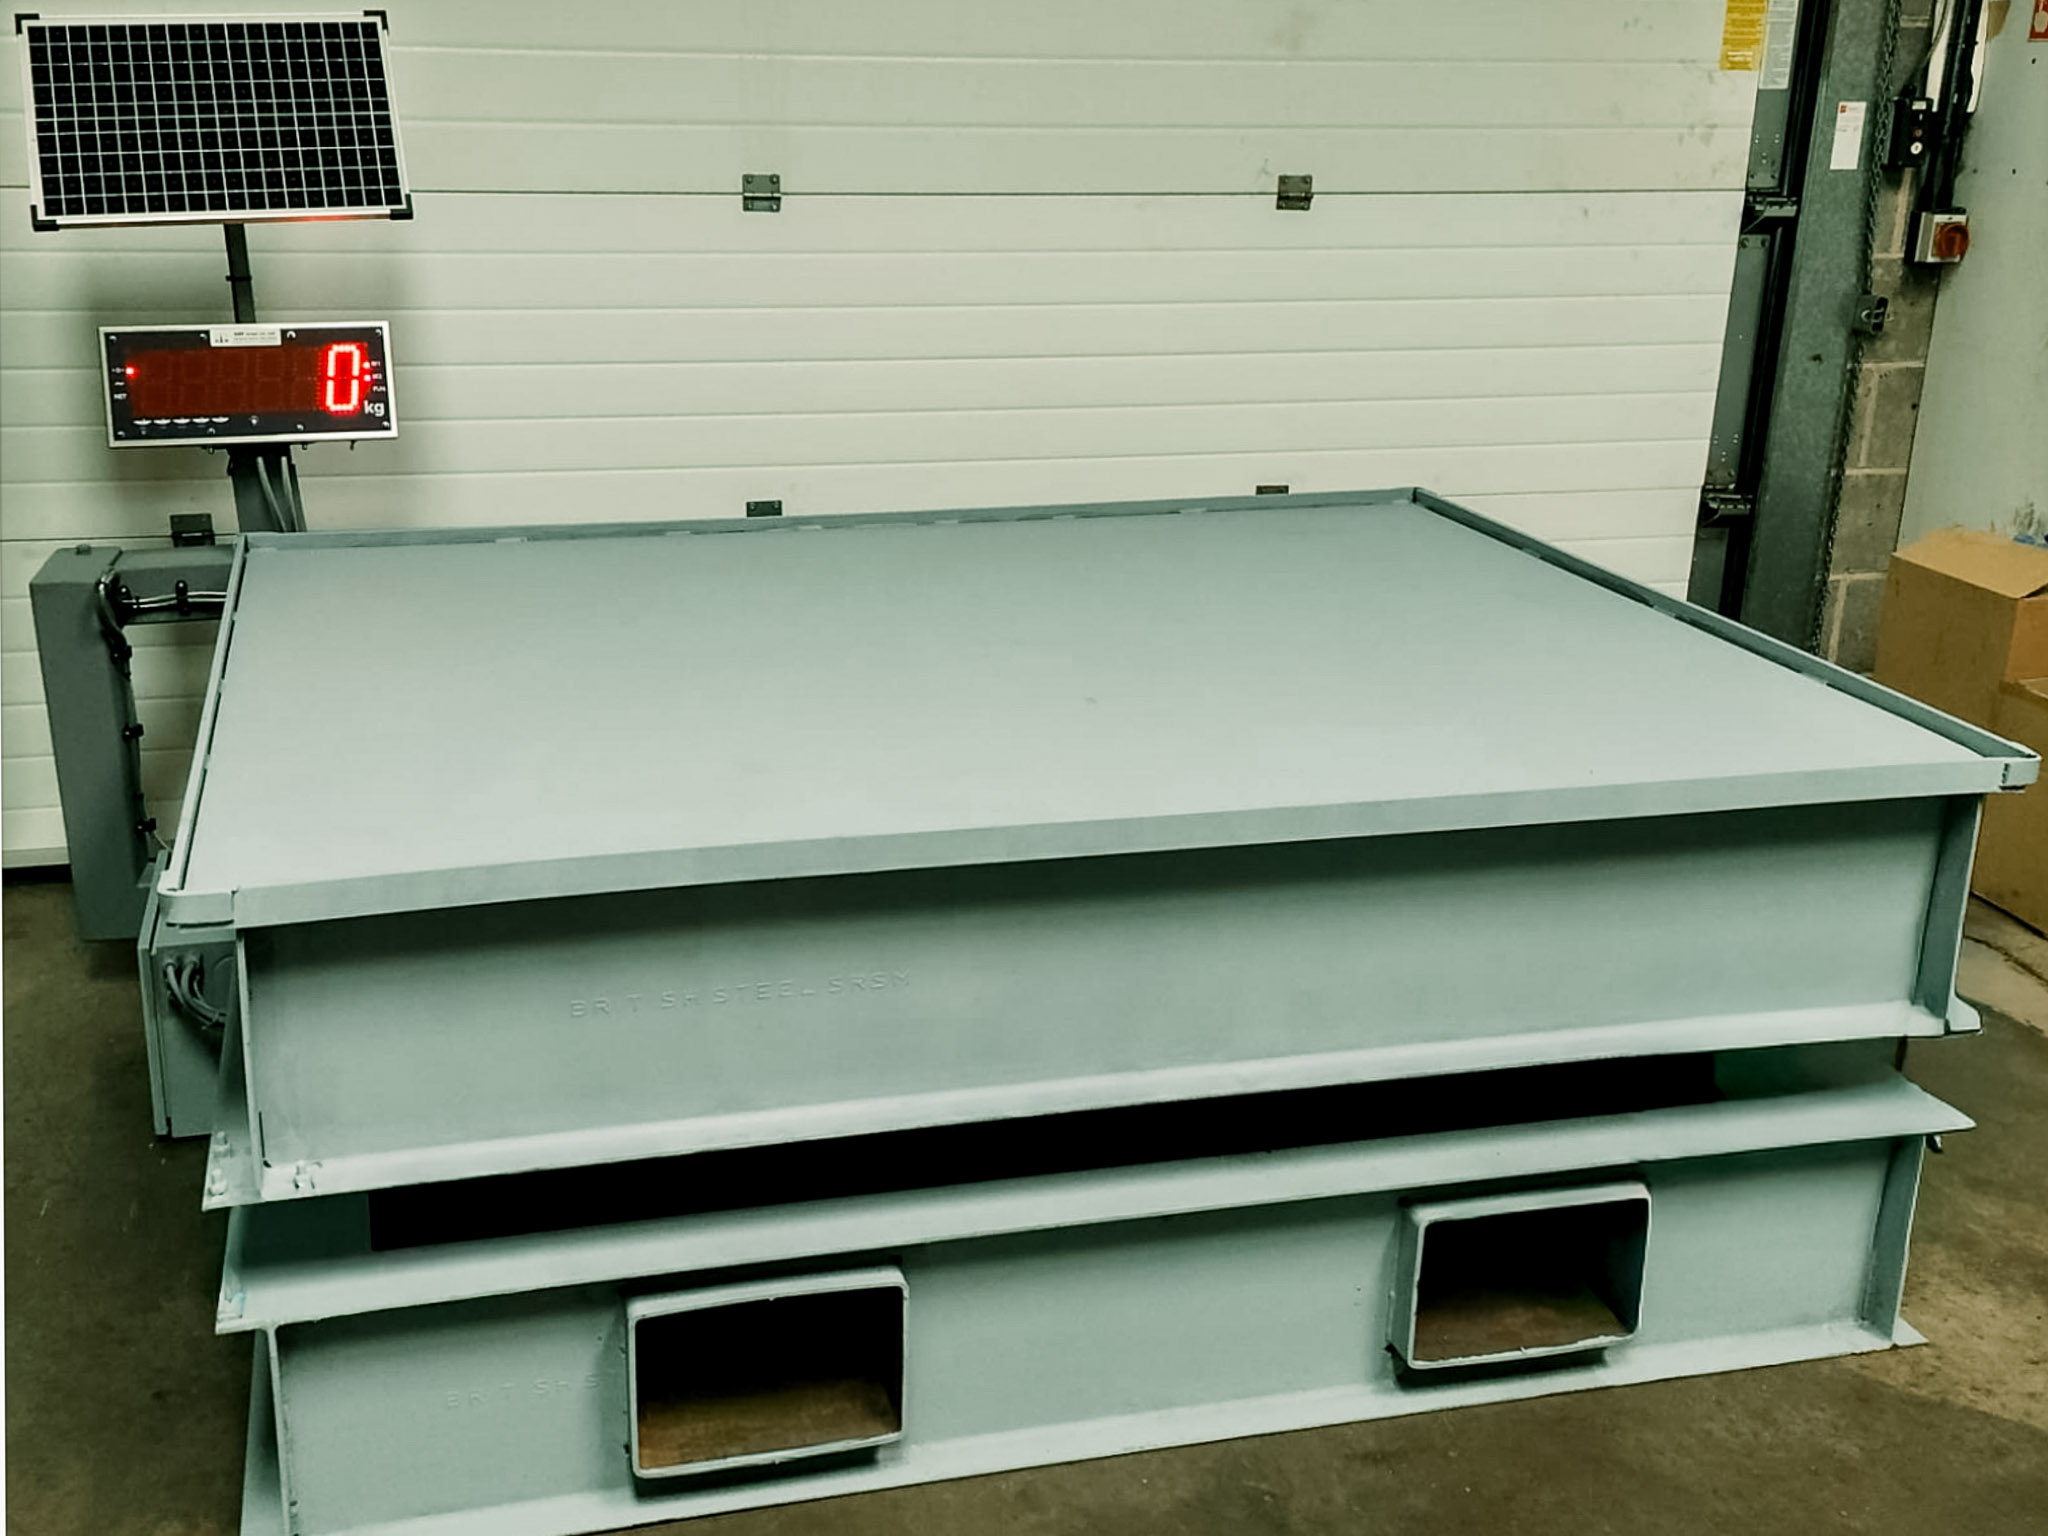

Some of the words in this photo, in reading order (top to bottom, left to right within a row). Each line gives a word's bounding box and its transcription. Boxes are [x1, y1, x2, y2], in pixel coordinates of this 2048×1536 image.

[325, 344, 361, 411] 0
[363, 400, 385, 417] kg
[570, 988, 703, 1018] BRTSH
